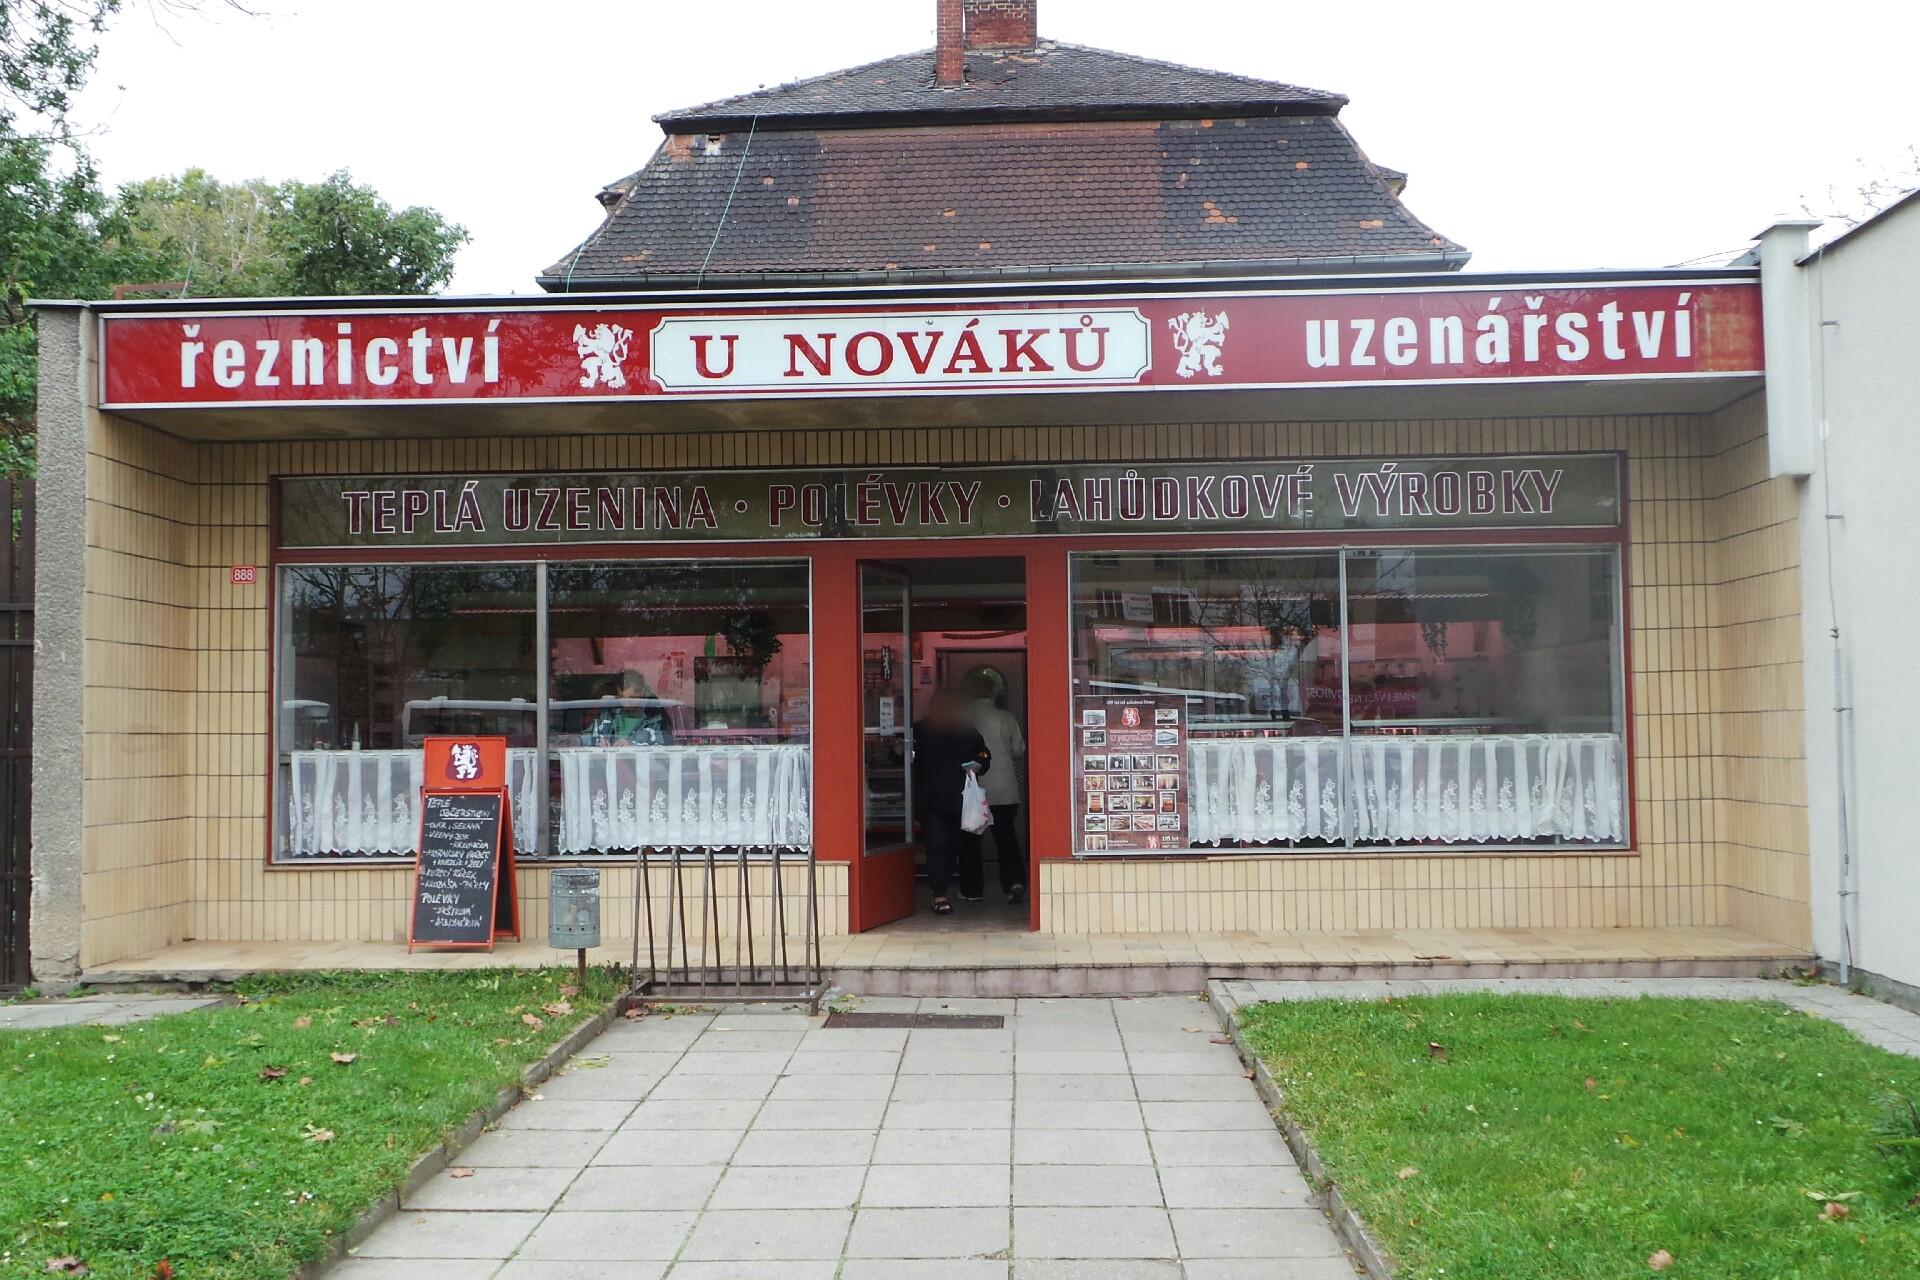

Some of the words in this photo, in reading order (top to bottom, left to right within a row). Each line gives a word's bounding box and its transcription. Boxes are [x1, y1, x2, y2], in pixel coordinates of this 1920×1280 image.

[180, 319, 500, 389] řeznictví
[690, 335, 739, 378] U
[783, 315, 1110, 377] NOVÁKŮ
[1305, 292, 1692, 368] uzenářství
[341, 480, 486, 535] TEPLÁ
[503, 485, 718, 532] UZENINA
[768, 474, 982, 527] POLÉVKY
[1030, 465, 1315, 522] LAHŮDKOVÉ
[1334, 463, 1564, 516] VÝROBKY
[234, 569, 253, 581] 888
[428, 797, 453, 808] TEPLÉ
[421, 890, 460, 904] POLÉVKY
